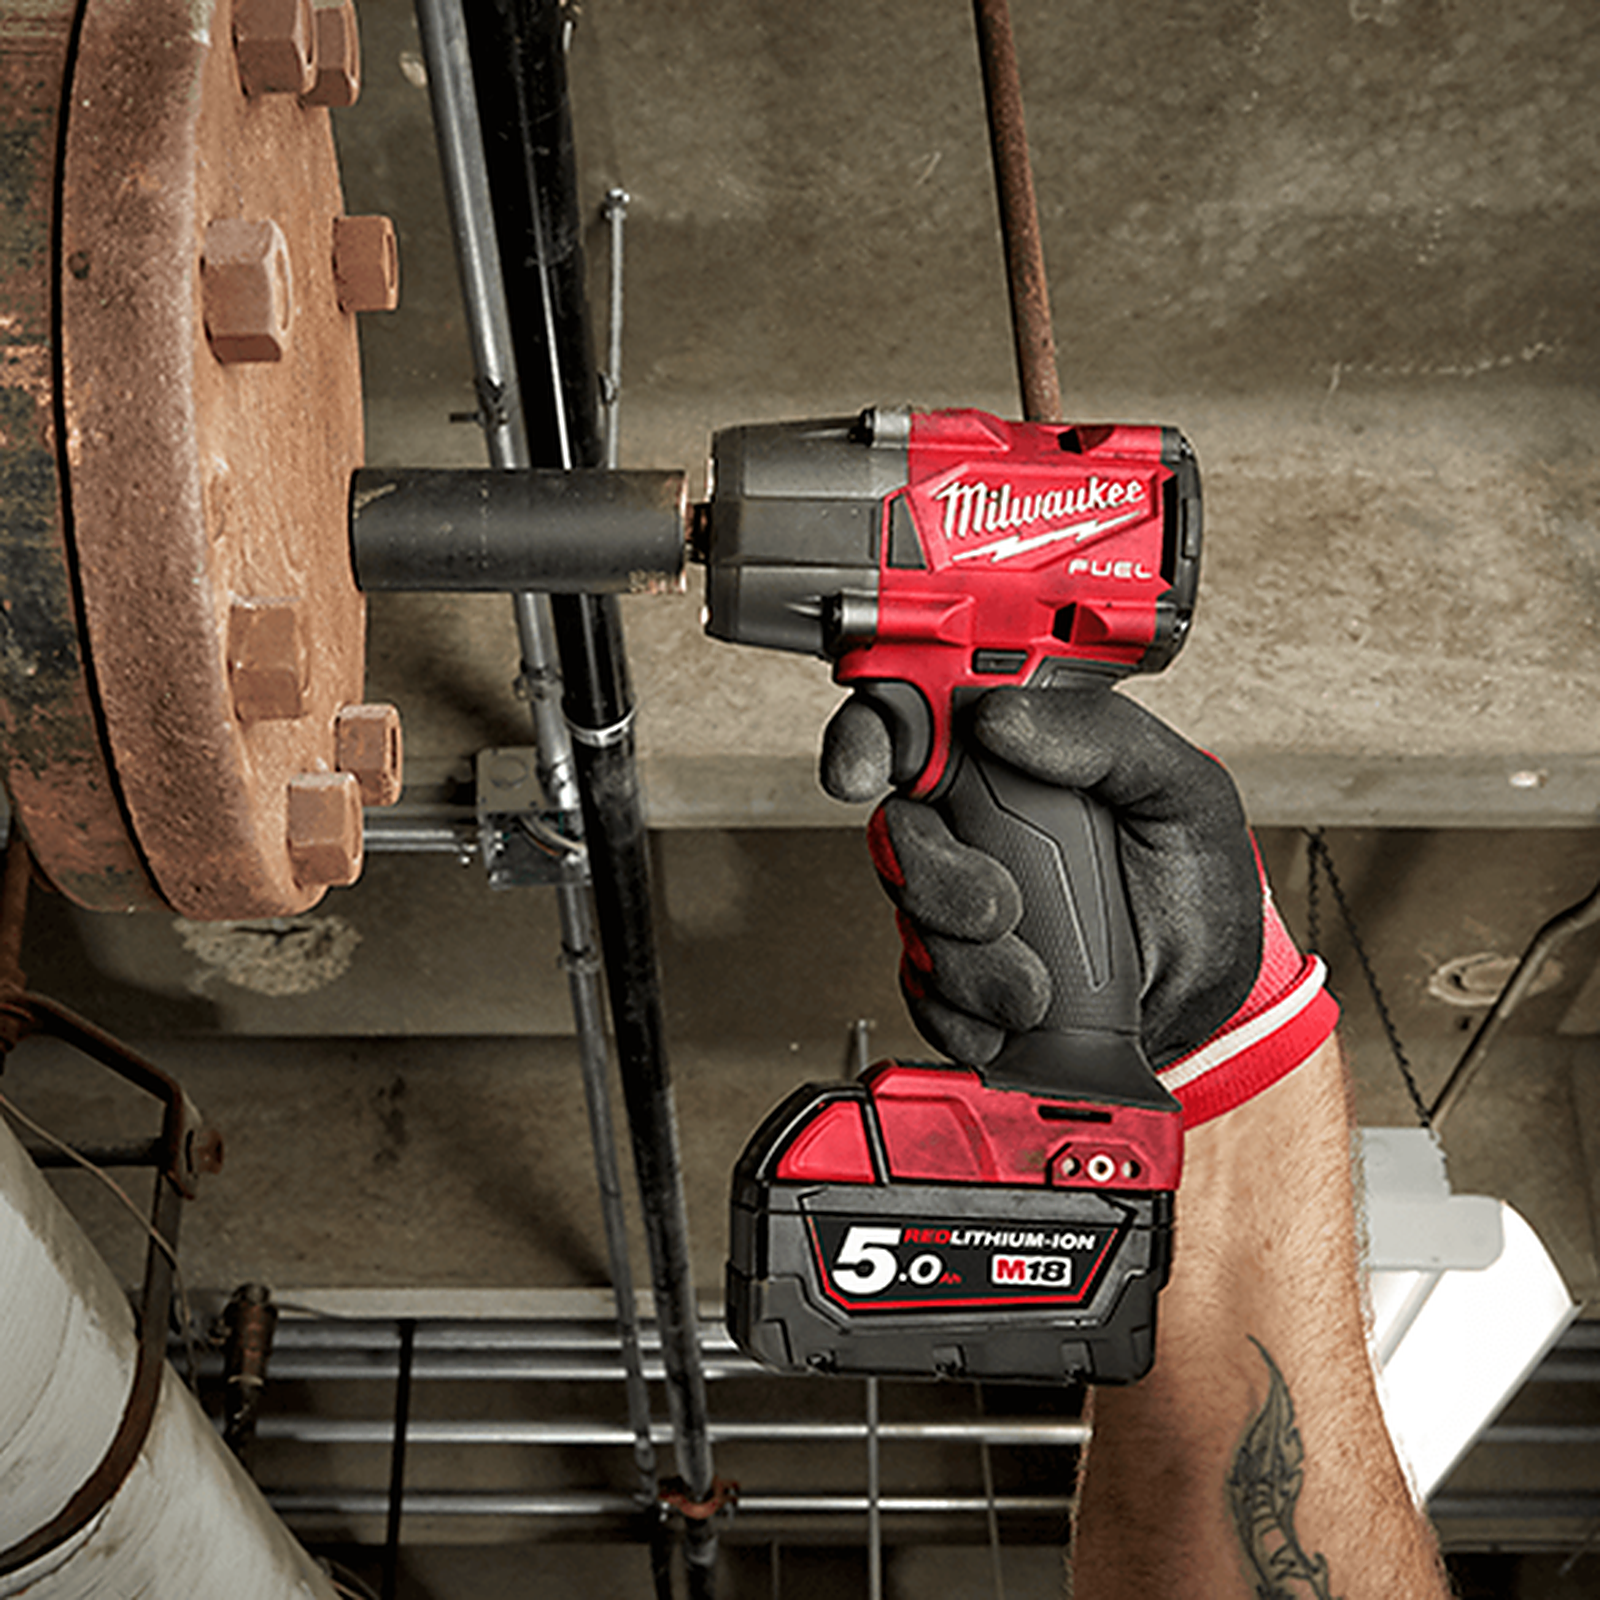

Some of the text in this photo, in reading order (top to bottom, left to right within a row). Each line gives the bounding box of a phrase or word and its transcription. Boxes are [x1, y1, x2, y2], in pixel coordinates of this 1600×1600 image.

[936, 476, 1145, 539] Milwaukee
[1068, 558, 1152, 578] FUEL
[996, 1258, 1067, 1282] M18
